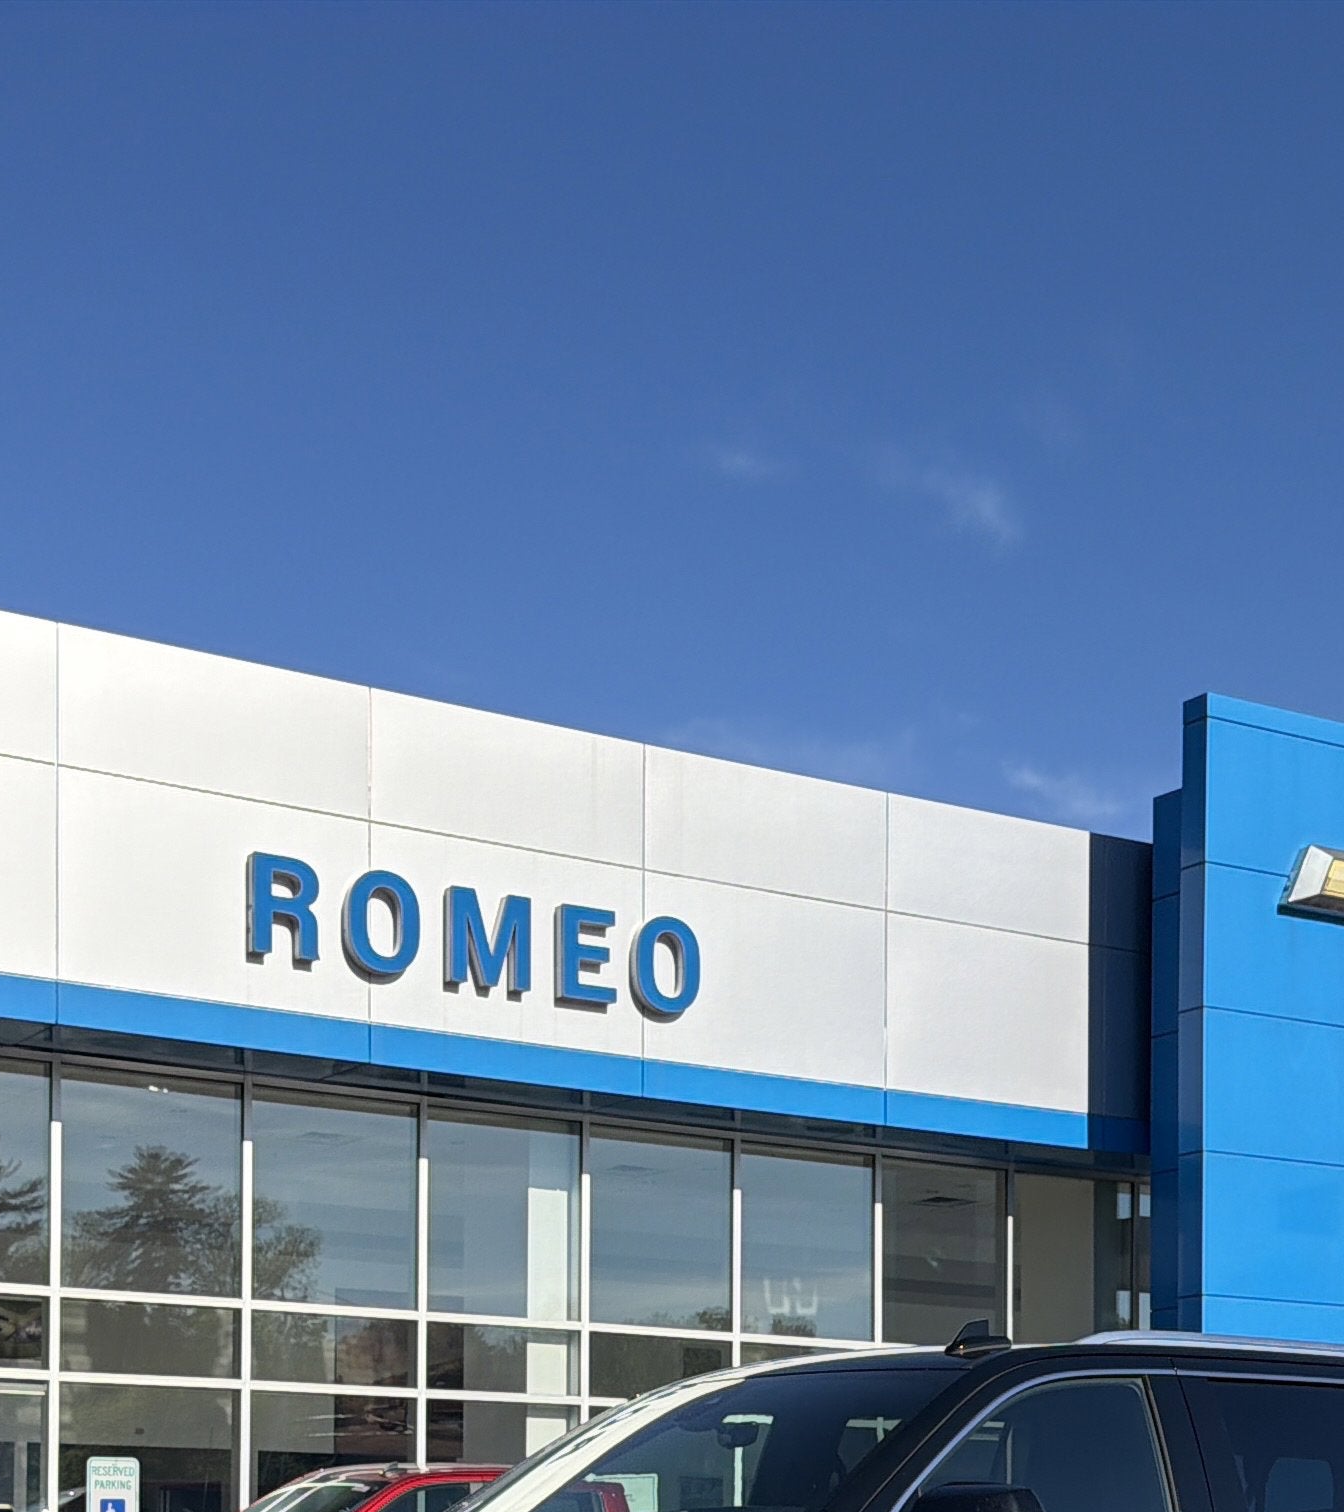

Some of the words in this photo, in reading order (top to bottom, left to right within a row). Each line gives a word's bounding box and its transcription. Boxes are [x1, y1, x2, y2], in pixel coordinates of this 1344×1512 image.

[246, 851, 700, 1015] ROMEO
[91, 1466, 135, 1477] RESERVED
[94, 1480, 132, 1490] PARKING
